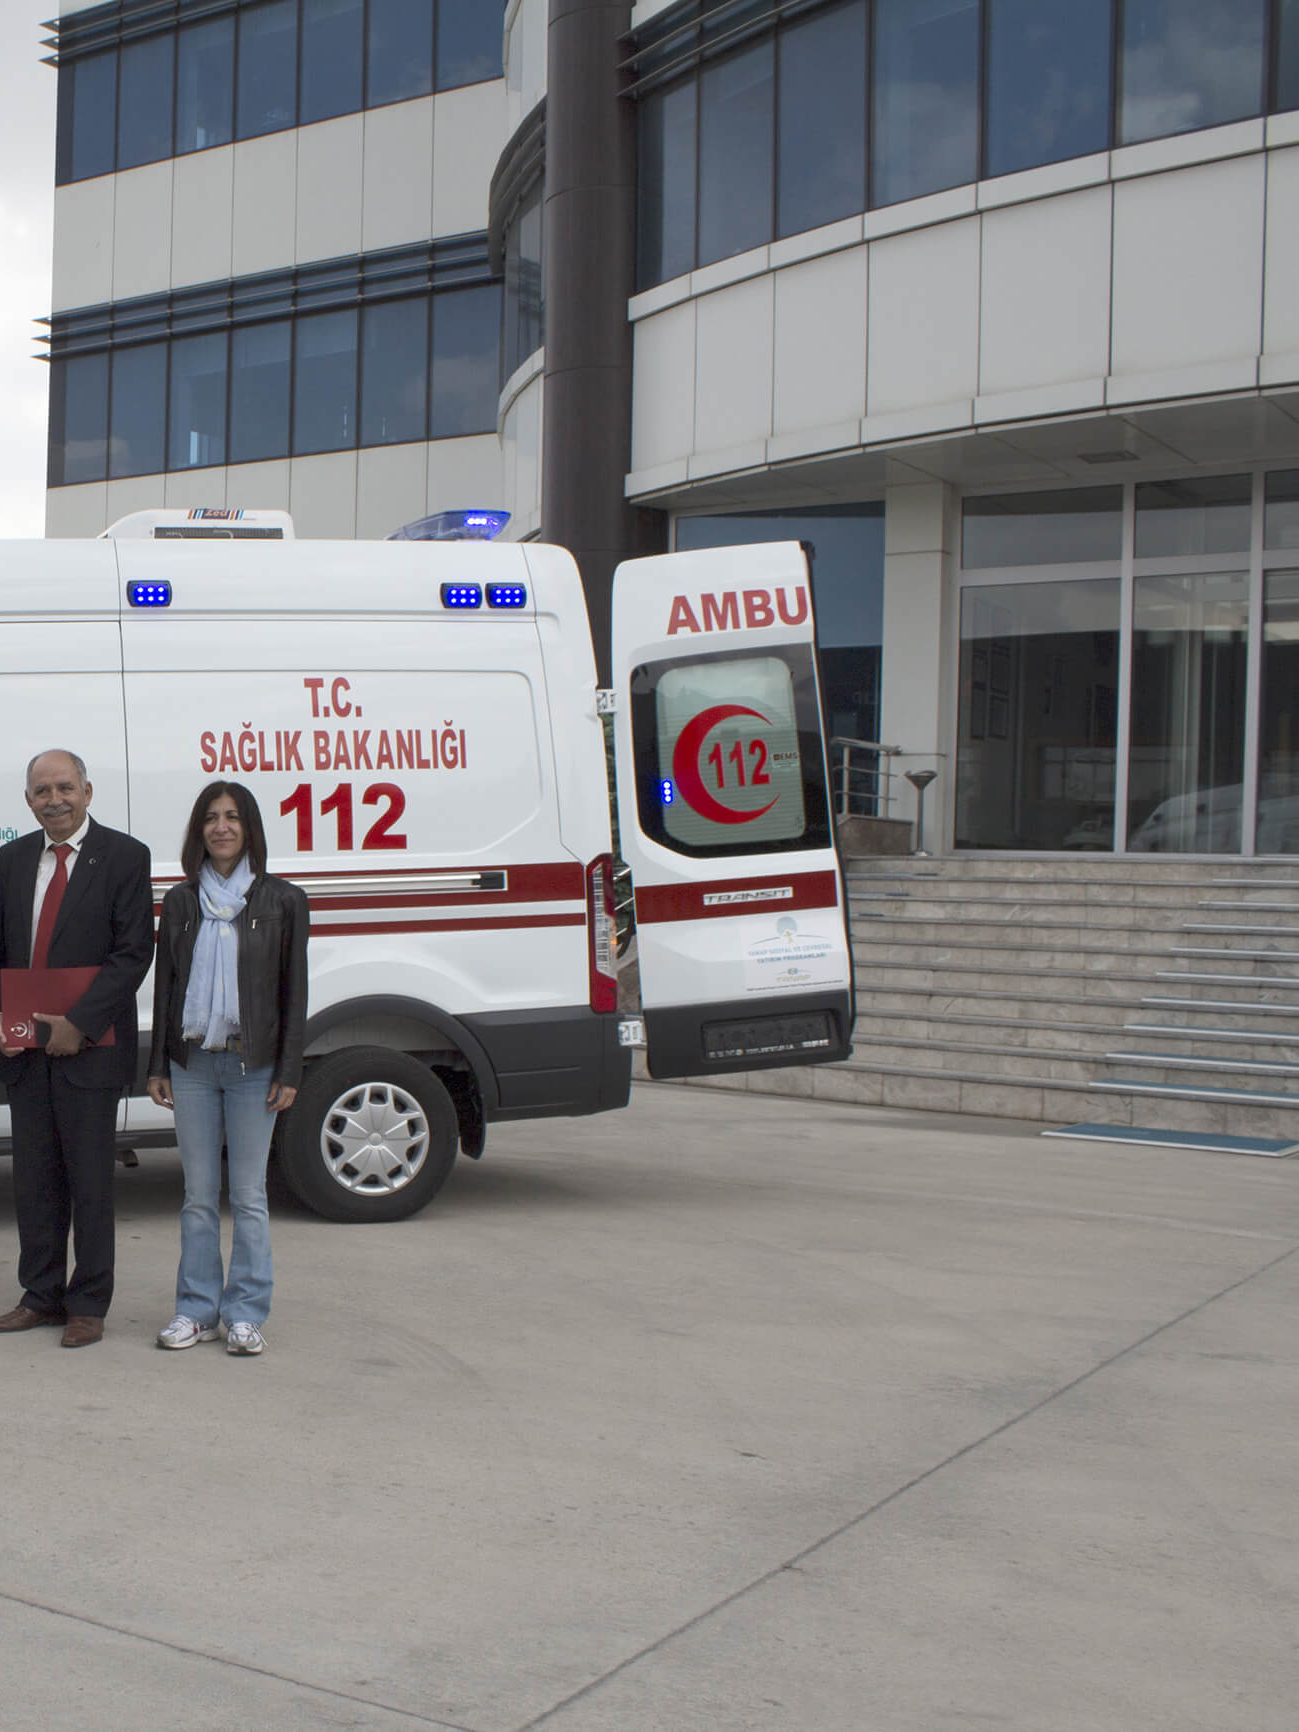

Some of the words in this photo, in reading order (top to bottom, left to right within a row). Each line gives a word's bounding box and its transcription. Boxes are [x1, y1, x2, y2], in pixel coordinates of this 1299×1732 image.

[667, 587, 808, 635] AMBU
[304, 677, 362, 718] T.C.
[200, 721, 304, 773] SAĞLIK
[314, 720, 467, 770] BAKANLIĞI
[709, 739, 770, 788] 112
[280, 782, 407, 851] 112
[706, 889, 790, 904] TRANSIT
